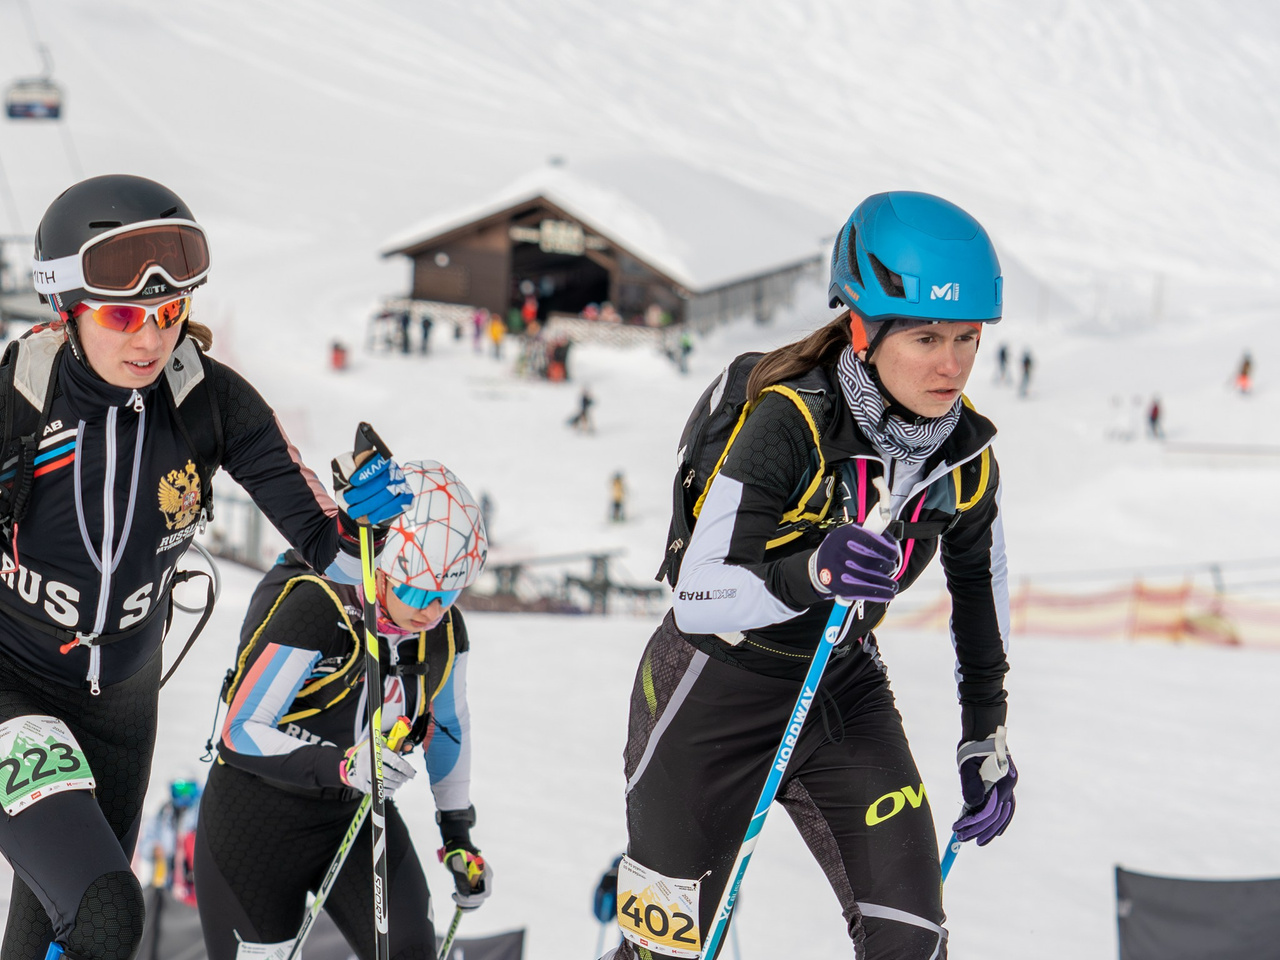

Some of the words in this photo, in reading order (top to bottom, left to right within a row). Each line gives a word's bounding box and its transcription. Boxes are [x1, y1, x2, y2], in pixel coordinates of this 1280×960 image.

[678, 588, 737, 601] SKITRAB
[775, 686, 815, 773] NORDWAY
[375, 877, 383, 924] SPORT
[621, 894, 697, 945] 402
